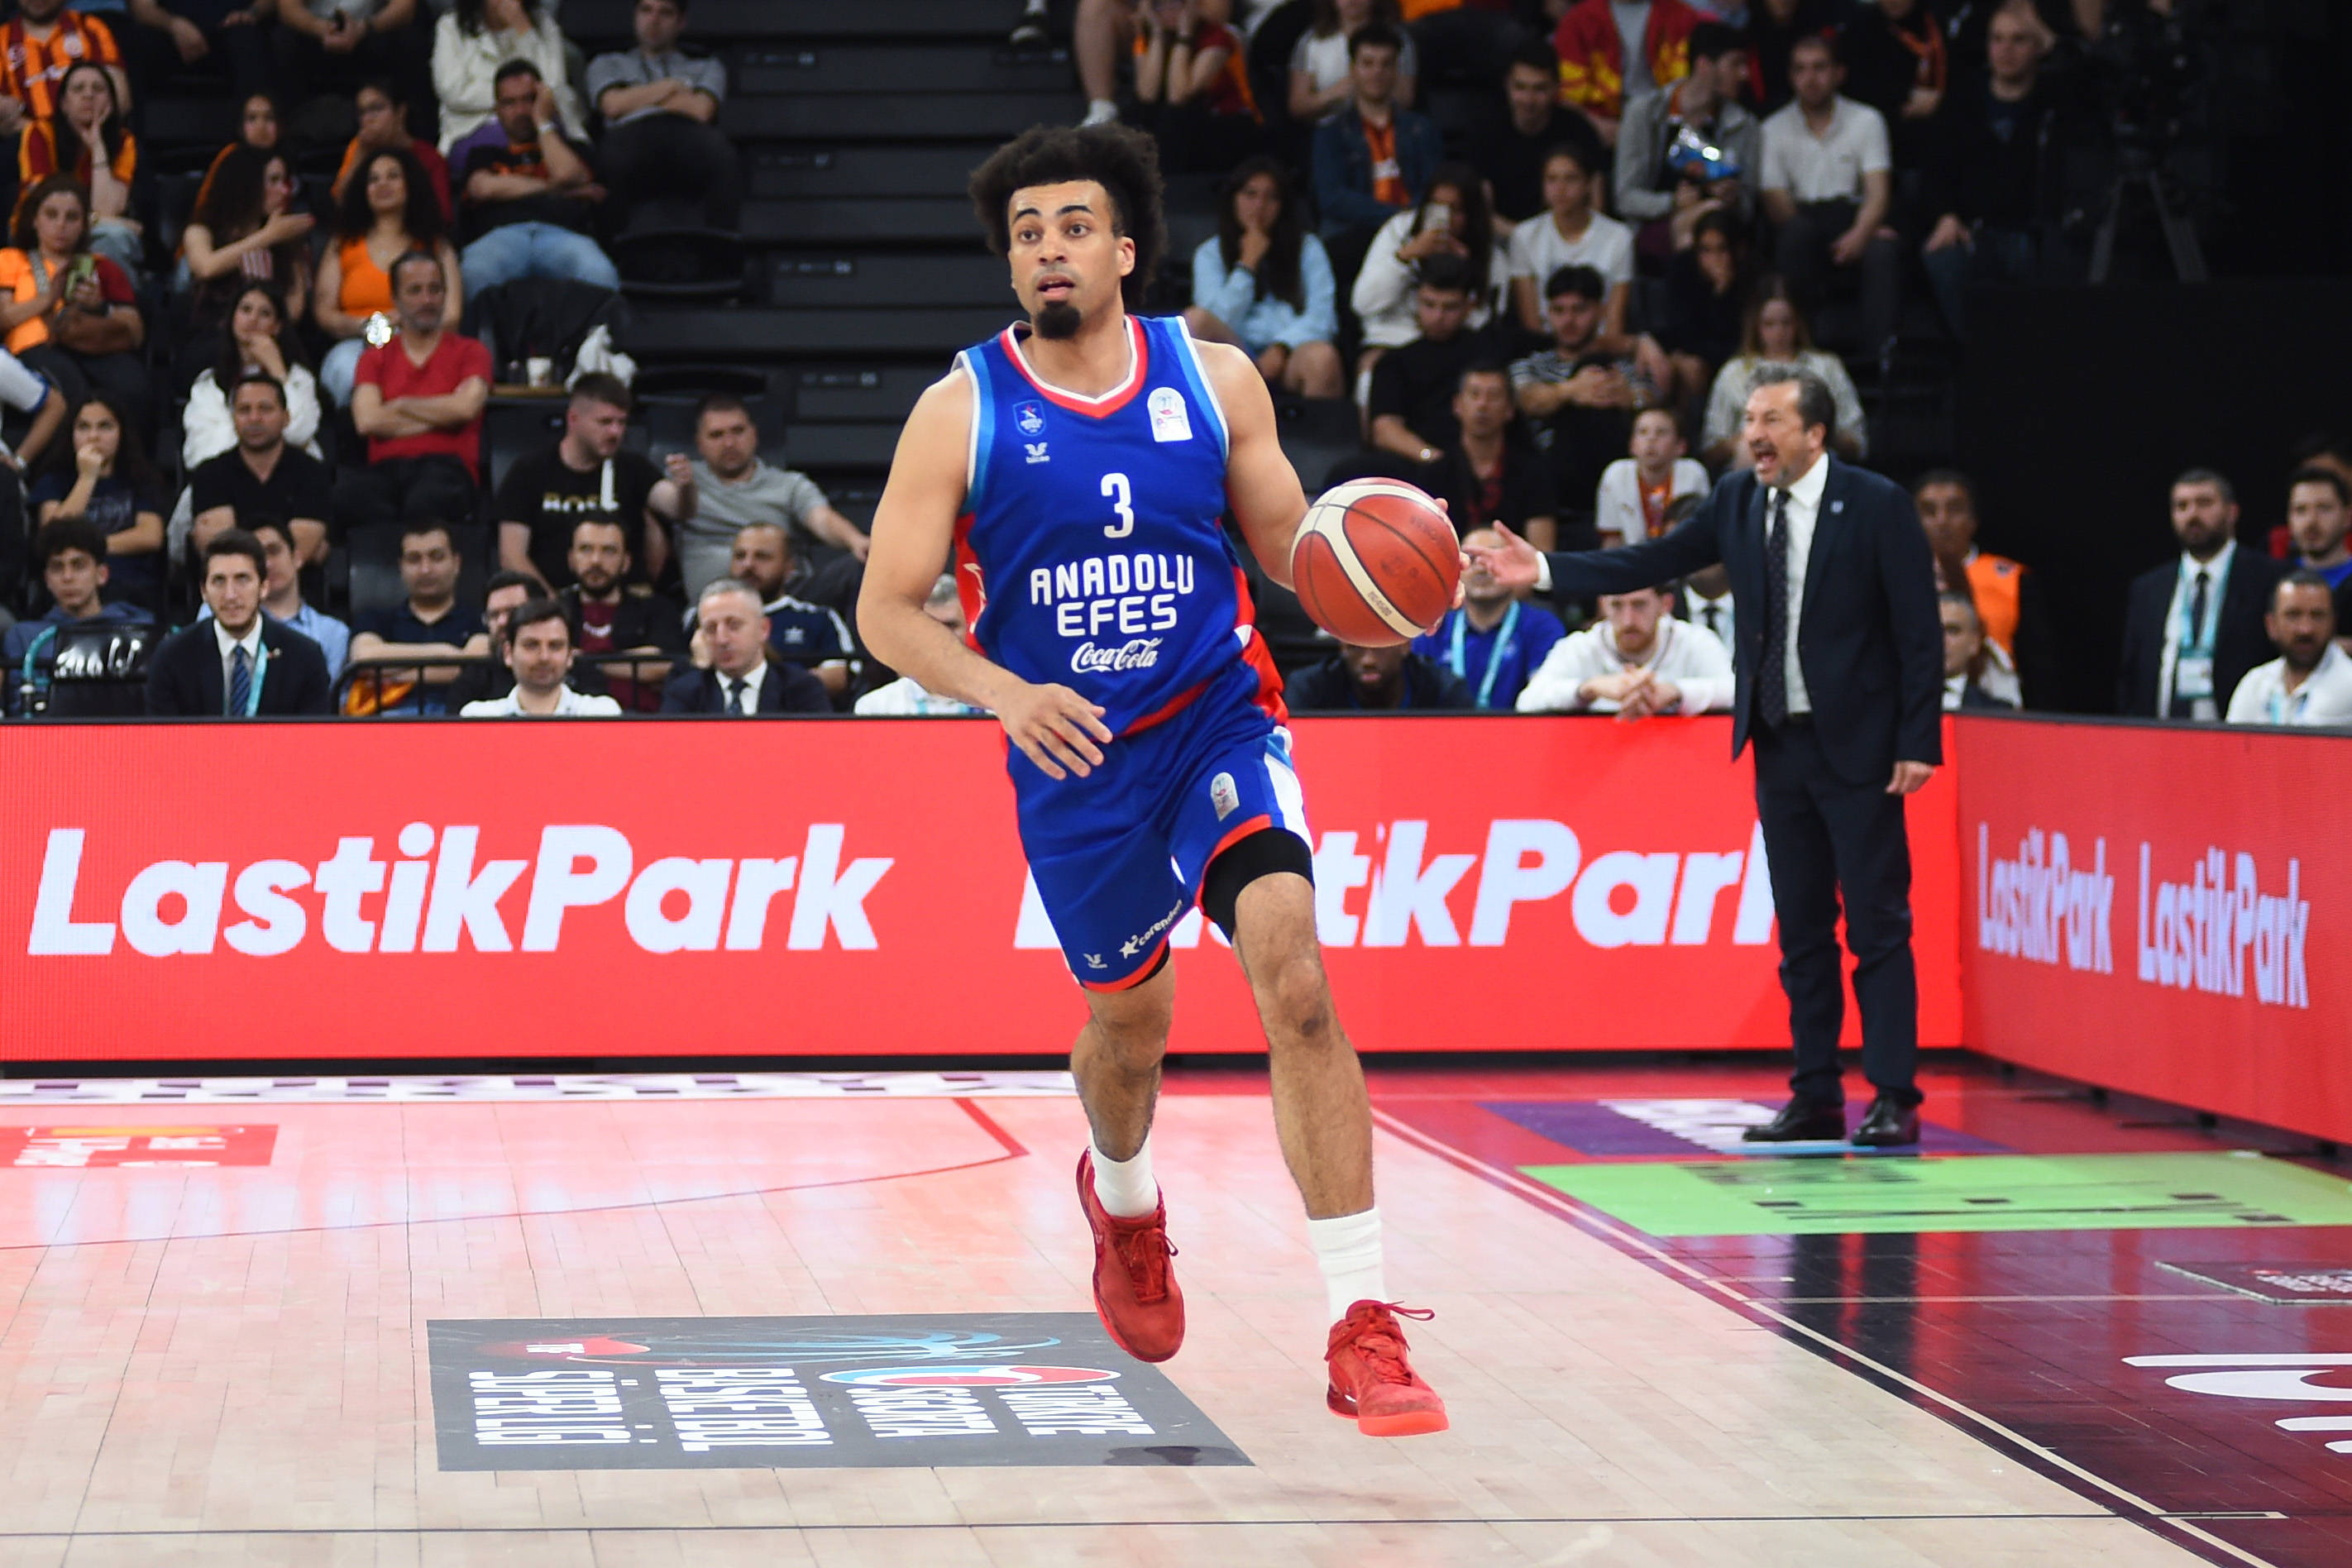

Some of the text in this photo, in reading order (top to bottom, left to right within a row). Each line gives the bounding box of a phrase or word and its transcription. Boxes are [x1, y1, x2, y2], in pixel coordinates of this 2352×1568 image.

[1100, 472, 1135, 538] 3
[1030, 553, 1193, 605] ANADOLU
[1057, 594, 1177, 637] EFES
[27, 821, 894, 957] LastikPark
[1979, 822, 2115, 975] LastikPark
[2138, 841, 2310, 1009] LastikPark
[468, 1370, 638, 1416] SÜPER
[654, 1368, 834, 1452] BASKETBOL
